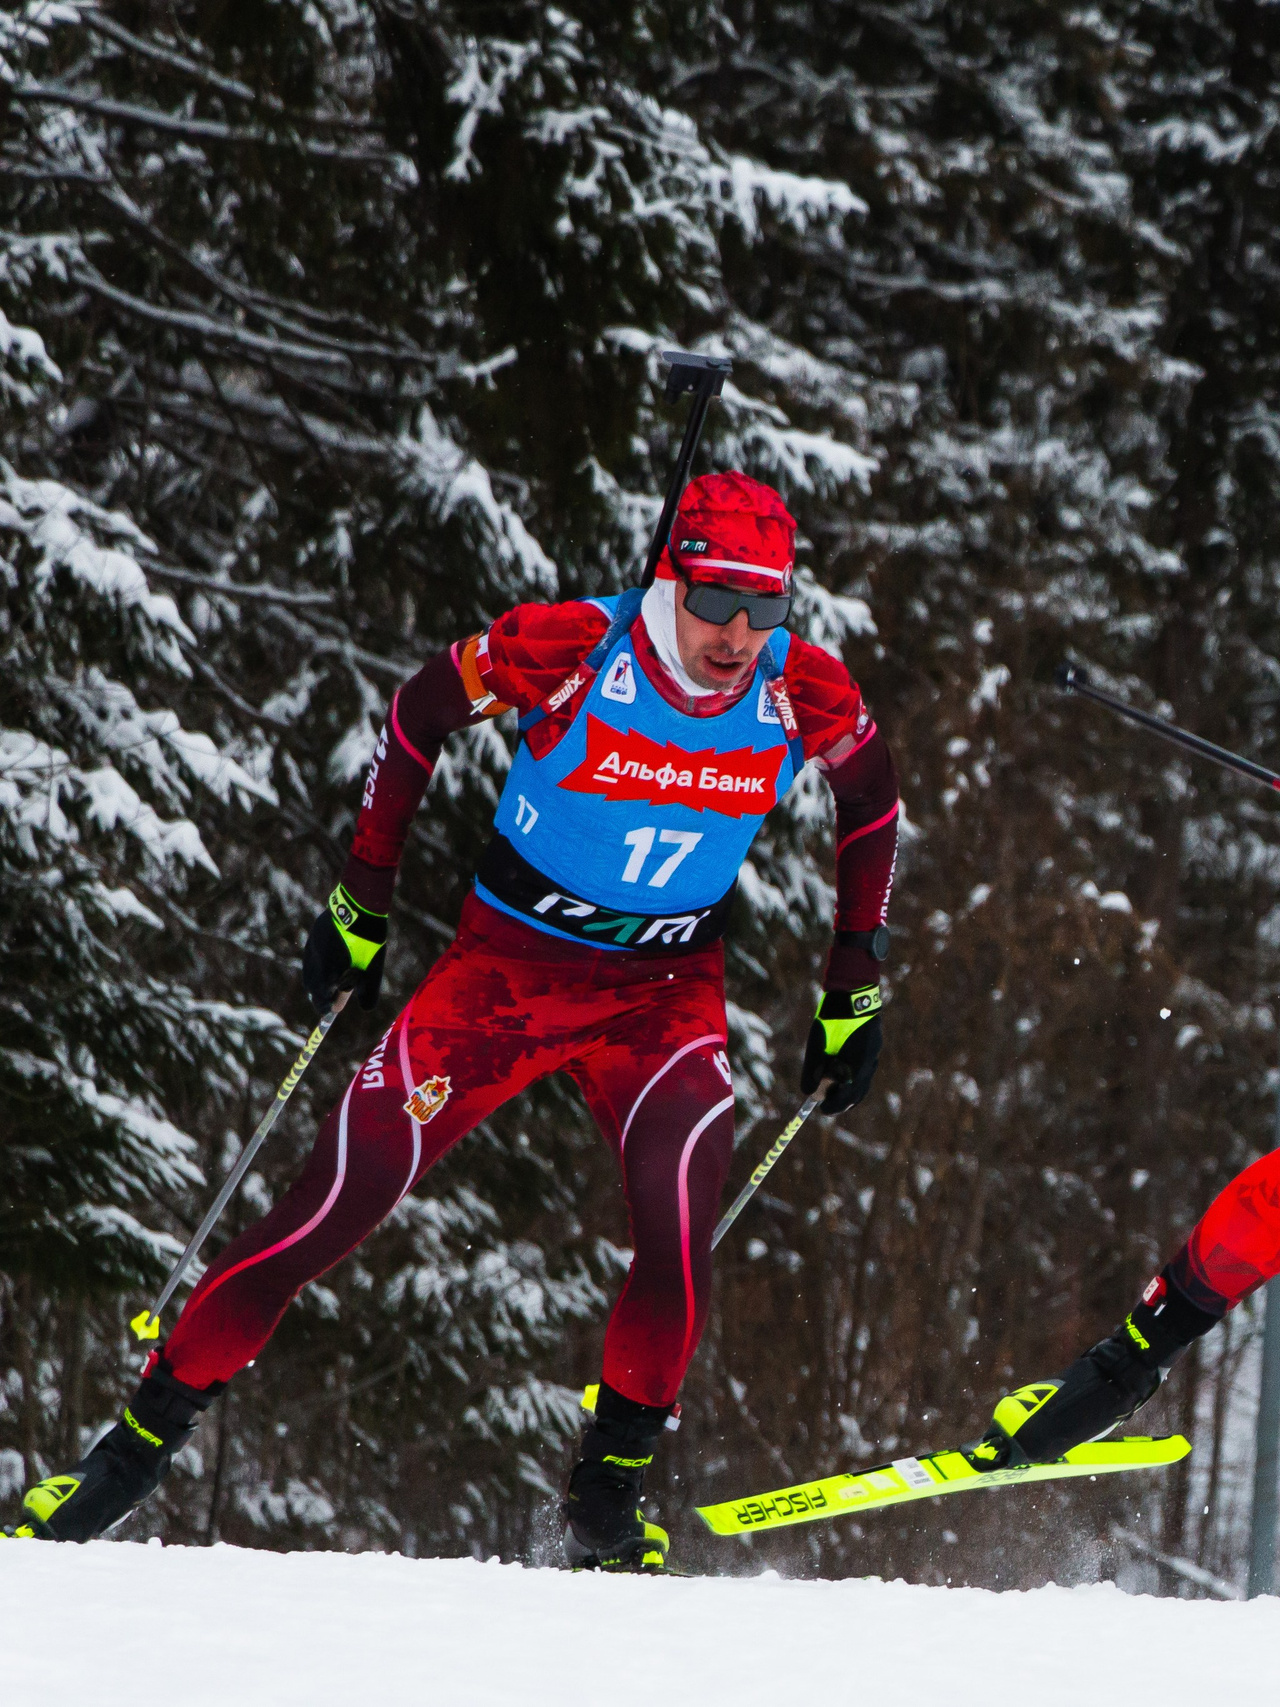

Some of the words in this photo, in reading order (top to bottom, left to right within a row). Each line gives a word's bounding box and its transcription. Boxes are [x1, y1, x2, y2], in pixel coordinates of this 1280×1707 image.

[680, 540, 707, 552] PARI
[593, 751, 693, 790] Альфа
[698, 767, 766, 793] Банк
[515, 794, 539, 835] 17
[621, 826, 704, 888] 17
[732, 1488, 828, 1525] FISCHER
